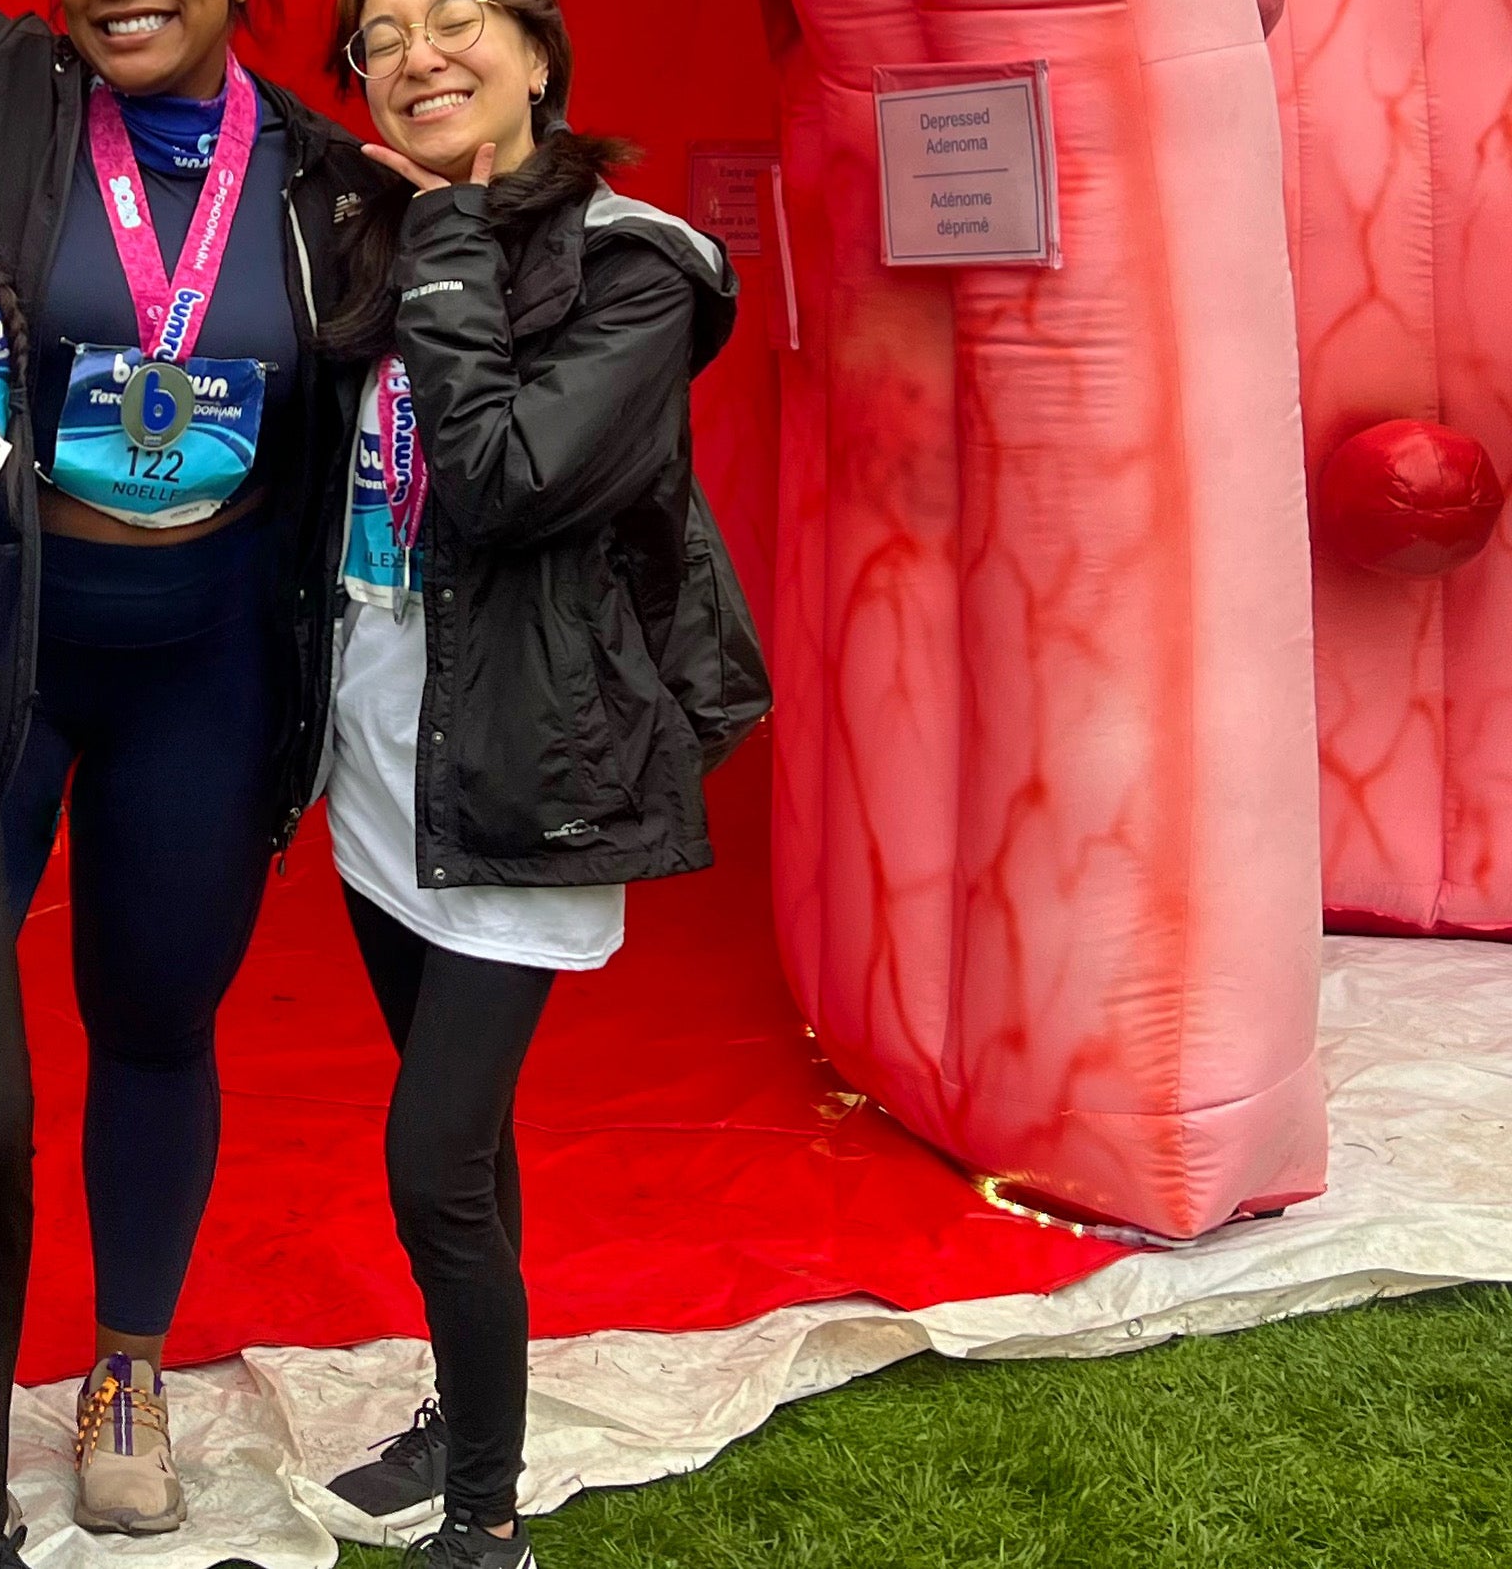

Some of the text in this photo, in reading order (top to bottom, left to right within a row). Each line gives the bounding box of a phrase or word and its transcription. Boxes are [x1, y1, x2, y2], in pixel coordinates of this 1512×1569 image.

[920, 108, 990, 132] Depressed
[926, 136, 988, 155] Adenoma
[931, 192, 992, 209] Adénome
[192, 187, 228, 271] PENDOPHARM
[937, 217, 990, 238] déprimé
[142, 369, 178, 434] b
[126, 446, 185, 483] 122
